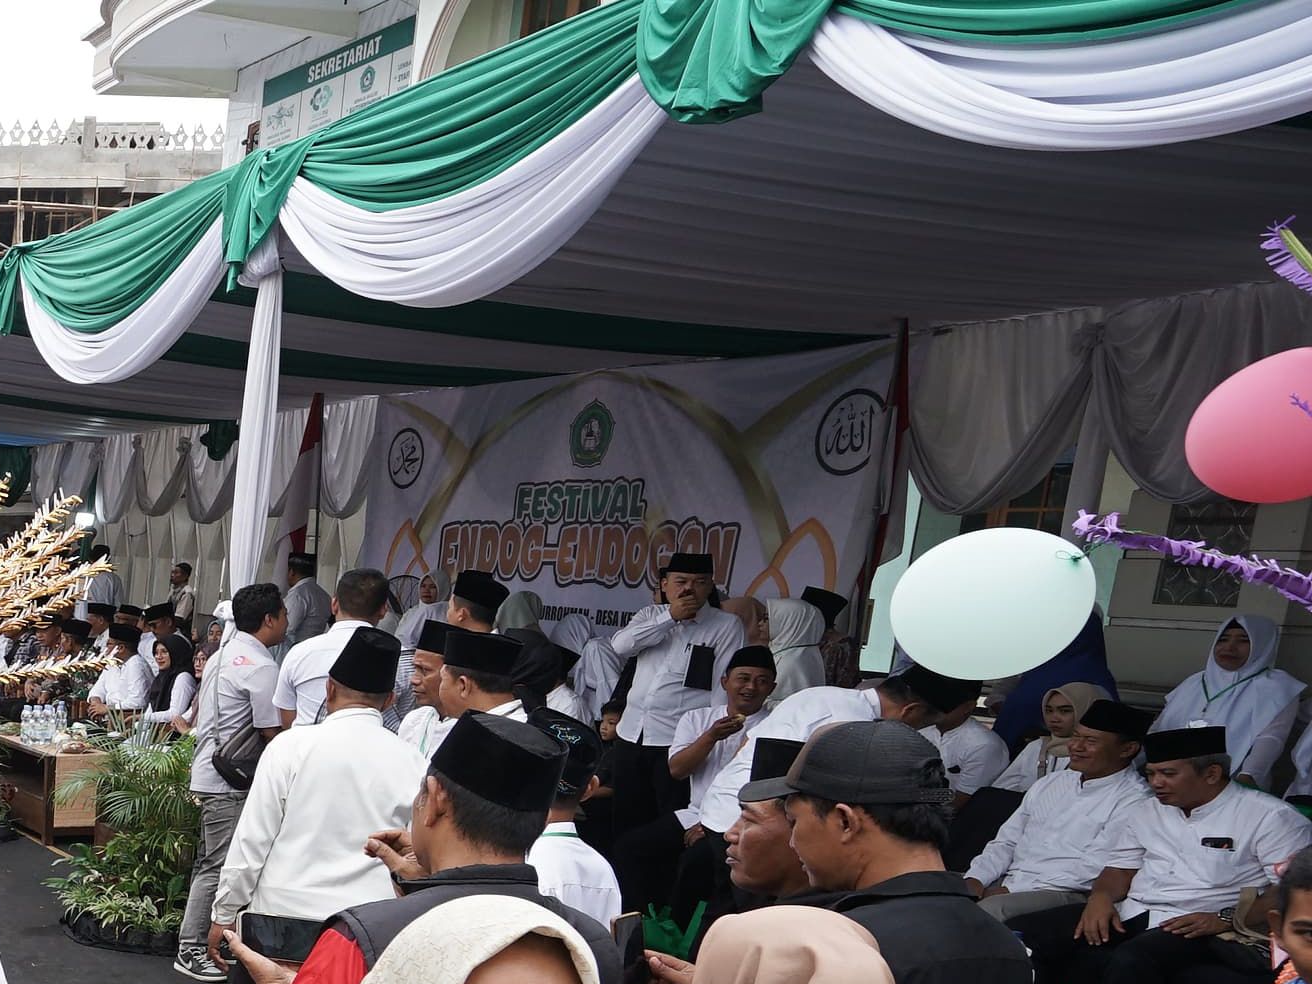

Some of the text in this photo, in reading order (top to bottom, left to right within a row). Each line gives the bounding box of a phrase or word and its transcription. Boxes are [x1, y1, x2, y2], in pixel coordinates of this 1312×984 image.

[308, 35, 383, 84] SEKRETARIAT
[515, 479, 648, 522] FESTIVAL
[595, 609, 618, 627] DESA
